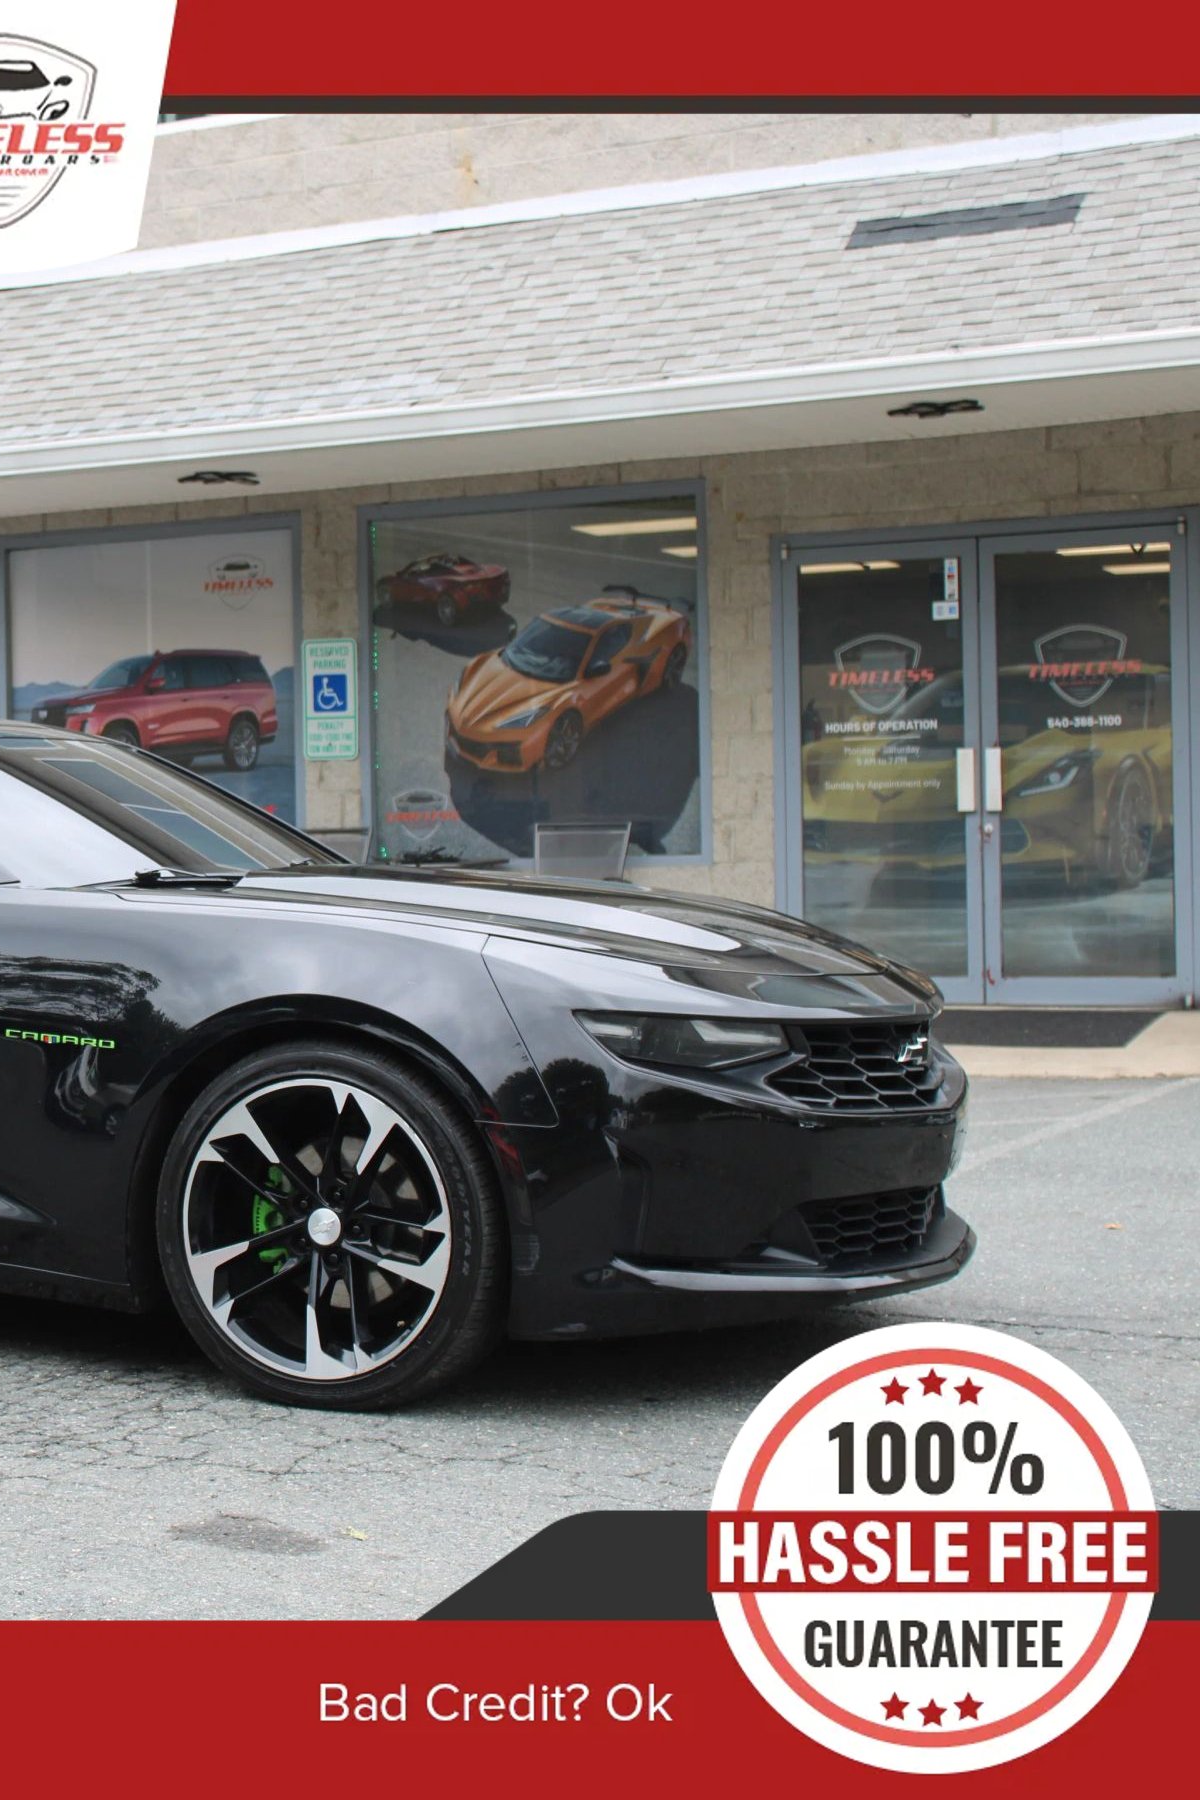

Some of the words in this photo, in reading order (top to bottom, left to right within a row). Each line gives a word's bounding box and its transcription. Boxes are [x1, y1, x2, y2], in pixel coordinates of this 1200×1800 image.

[309, 646, 349, 656] RESERVED
[313, 659, 346, 669] PARKING
[1029, 660, 1141, 679] TIMELESS
[828, 668, 935, 687] TIMELESS
[825, 722, 860, 734] HOURS
[862, 721, 876, 732] OF
[878, 719, 938, 731] OPERATION
[1046, 714, 1122, 728] 540-368-1100
[824, 780, 854, 791] Sunday
[867, 779, 921, 790] Appointment
[923, 779, 941, 789] only
[5, 1029, 115, 1049] CAMARO
